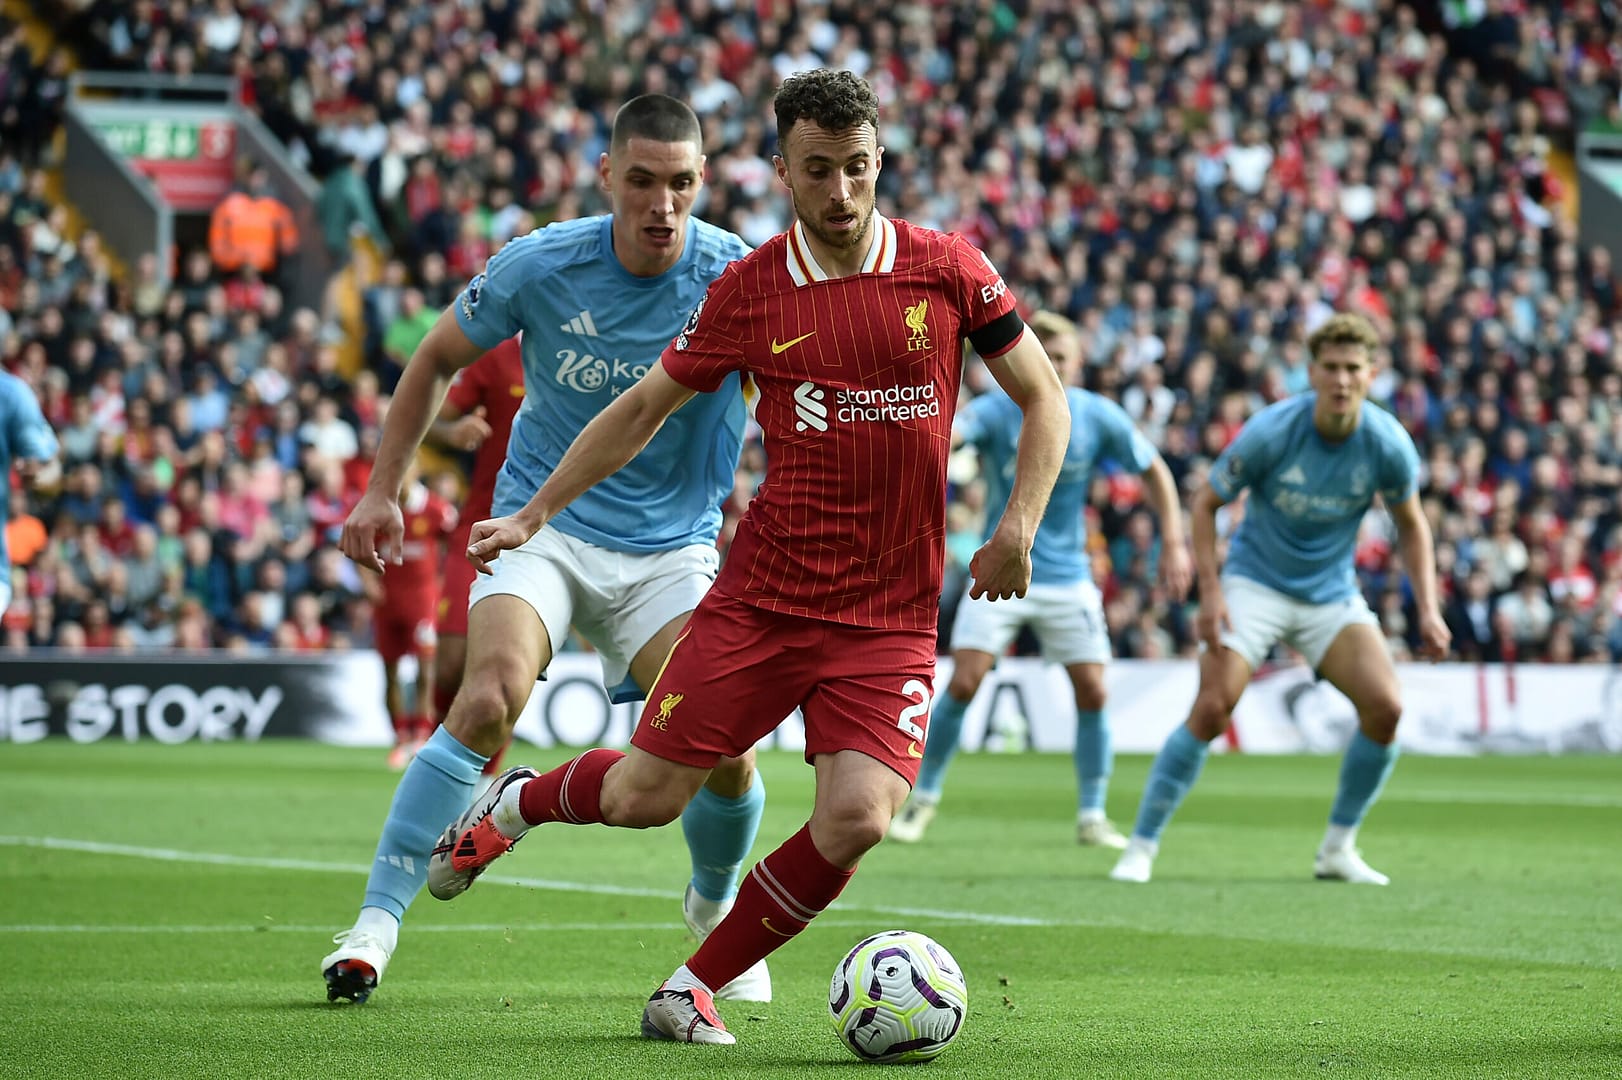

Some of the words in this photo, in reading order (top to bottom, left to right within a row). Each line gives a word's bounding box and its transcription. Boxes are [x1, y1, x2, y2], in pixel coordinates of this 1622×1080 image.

[837, 380, 934, 404] standard
[838, 398, 940, 422] chartered
[66, 683, 284, 745] STORY
[897, 679, 931, 742] 2
